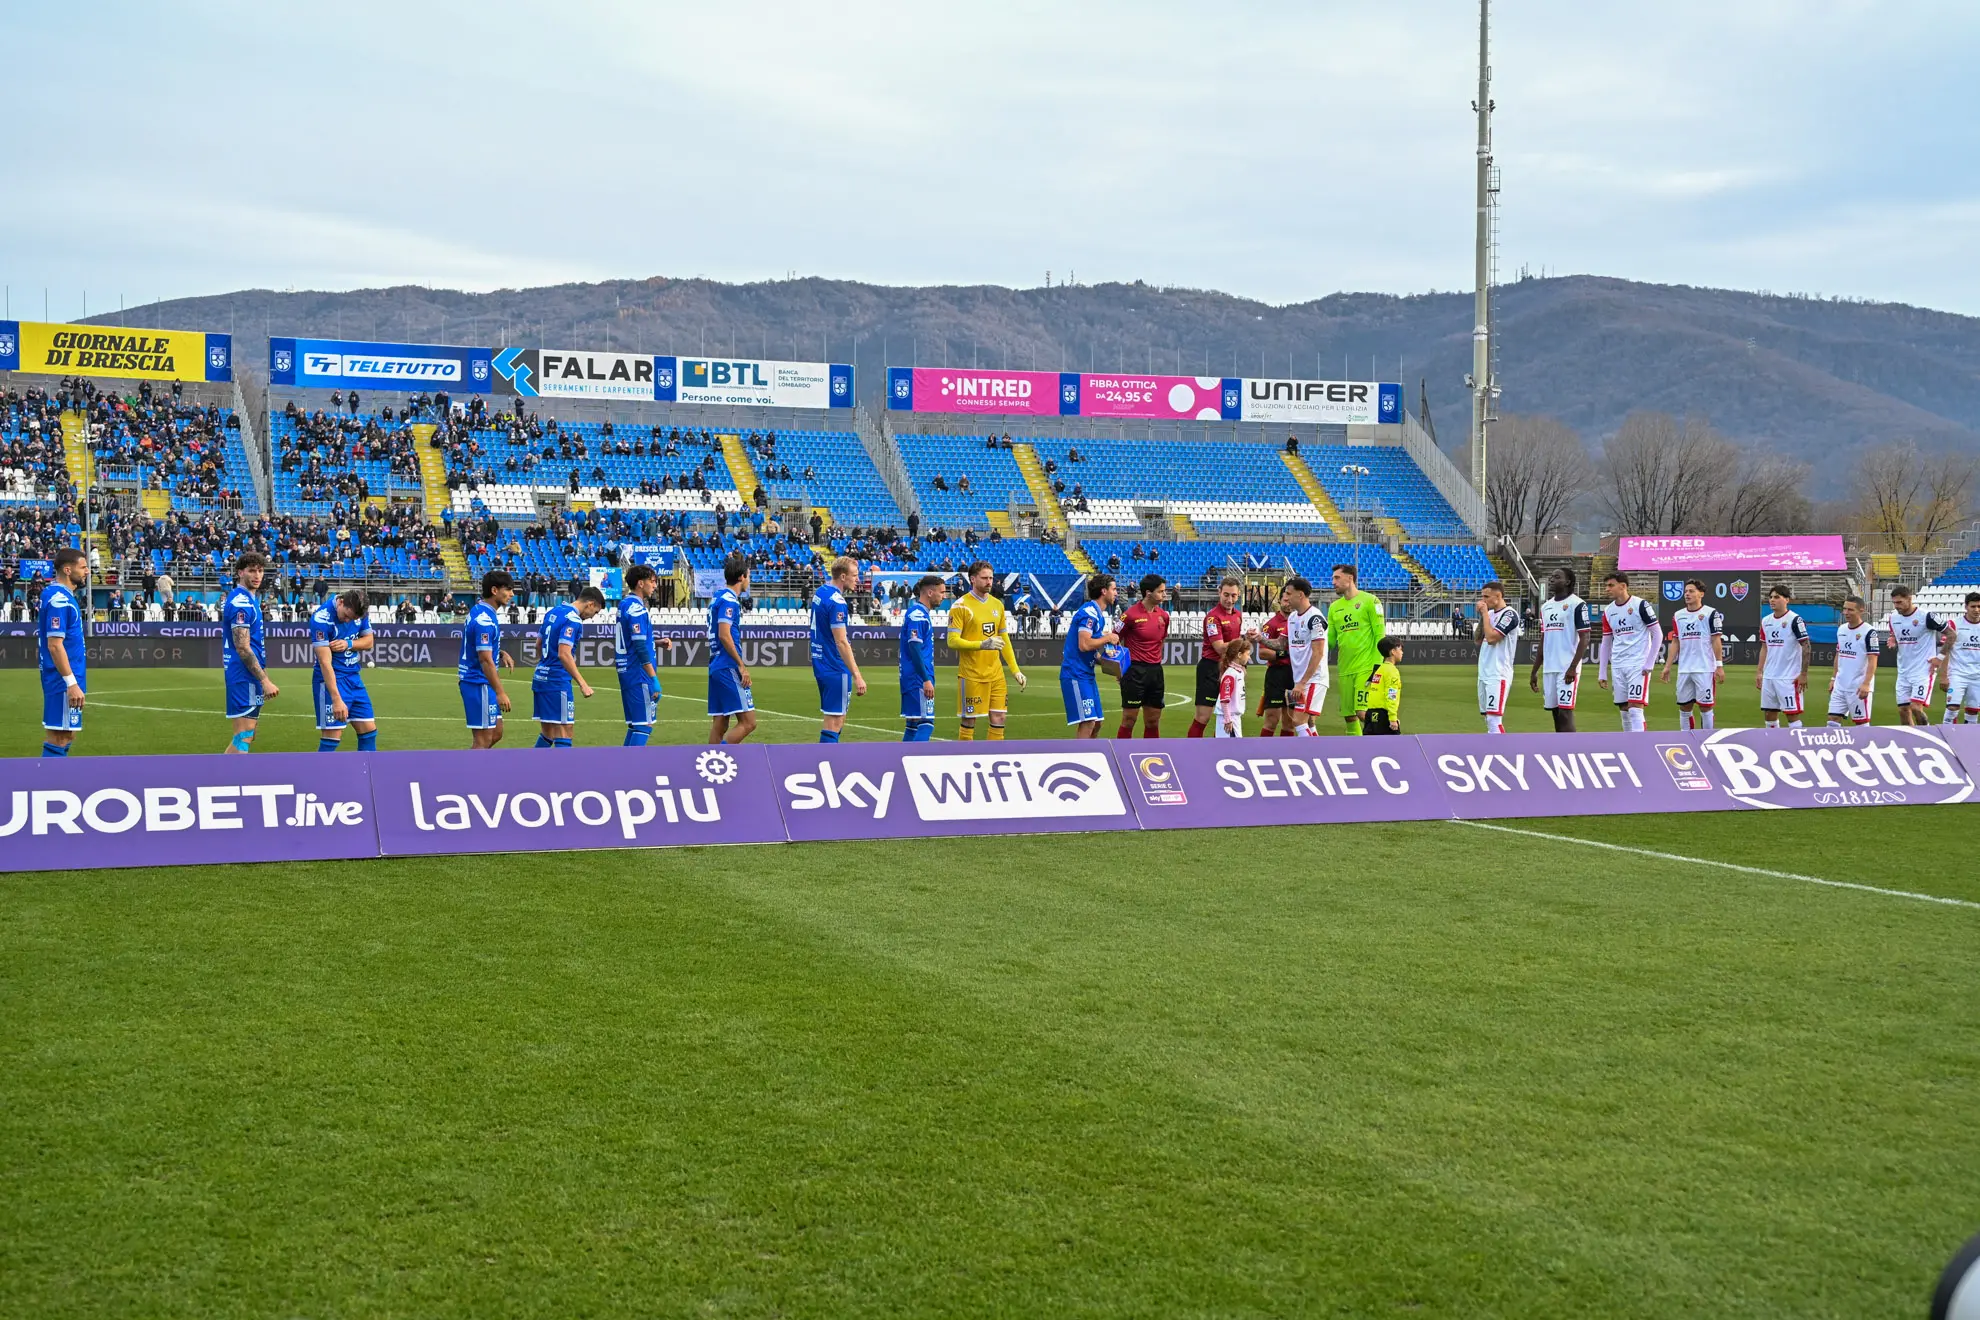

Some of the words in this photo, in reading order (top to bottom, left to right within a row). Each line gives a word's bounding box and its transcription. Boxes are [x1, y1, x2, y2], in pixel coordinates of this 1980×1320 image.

[53, 332, 169, 354] GIORNALE
[45, 350, 72, 366] DI
[76, 351, 175, 371] BRESCIA
[348, 360, 455, 376] TELETUTTO
[543, 356, 653, 382] FALAR
[712, 362, 768, 386] BTL
[543, 384, 591, 393] SERRAMENTI
[602, 385, 653, 395] CARPENTERIA
[956, 378, 1032, 398] INTRED
[1090, 380, 1120, 388] FIBRA
[1122, 380, 1157, 389] OTTICA
[682, 392, 722, 402] Persone
[726, 395, 752, 404] come
[756, 396, 774, 405] voi.
[1640, 539, 1706, 548] INTRED
[96, 623, 140, 633] UNION
[1560, 690, 1572, 702] 29
[1630, 684, 1642, 696] 20
[1706, 689, 1711, 700] 3
[1918, 686, 1924, 696] 8
[1488, 695, 1495, 707] 2
[1785, 696, 1794, 707] 11
[1855, 705, 1861, 716] 4
[1790, 728, 1855, 747] Fratelli
[1437, 754, 1530, 793] SKY
[1534, 752, 1643, 790] WIFI
[1706, 740, 1968, 795] Beretta
[920, 761, 1033, 804] wifi
[1216, 757, 1369, 799] SERIE
[1370, 756, 1410, 795] C
[784, 761, 896, 819] sky
[1840, 790, 1884, 805] 1812
